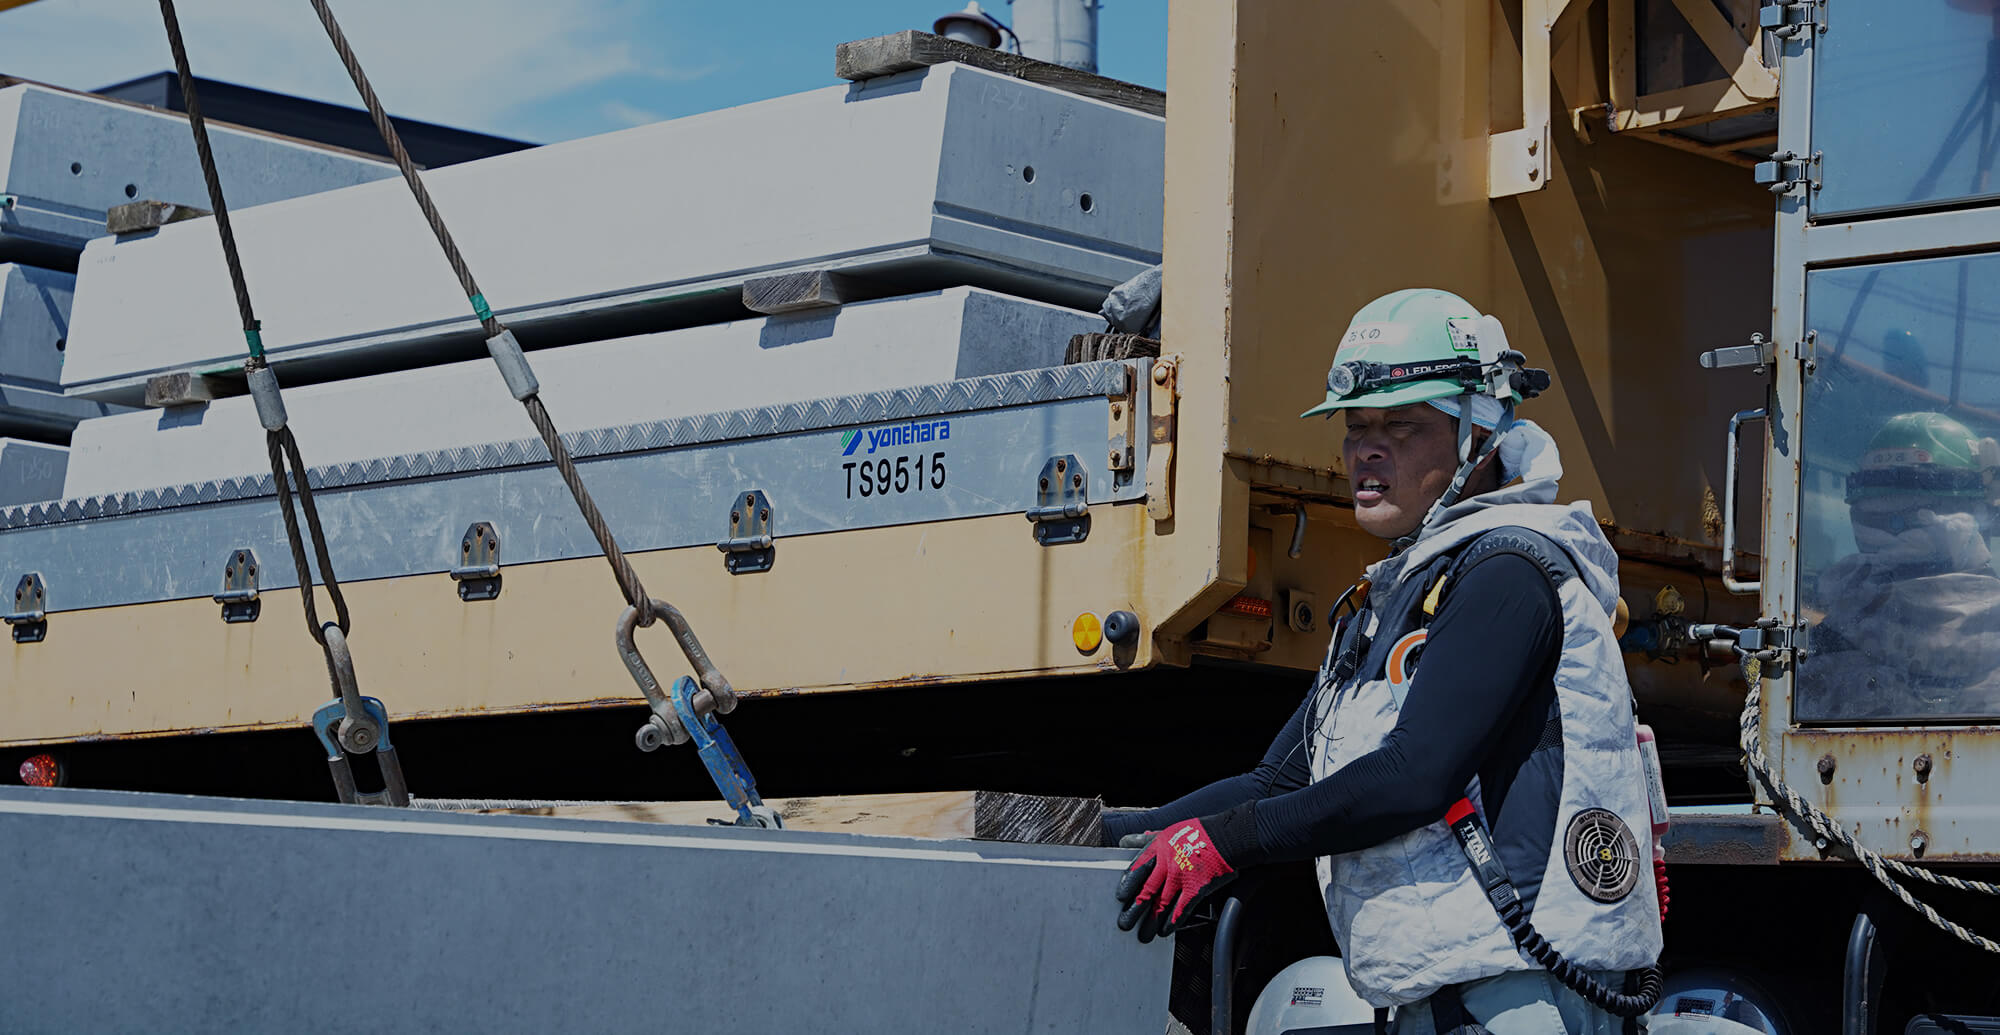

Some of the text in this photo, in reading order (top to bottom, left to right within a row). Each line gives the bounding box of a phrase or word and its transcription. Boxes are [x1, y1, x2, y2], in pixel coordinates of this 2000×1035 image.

[867, 421, 950, 454] yonehara
[843, 452, 946, 499] TS9515
[1463, 821, 1491, 865] TITAN
